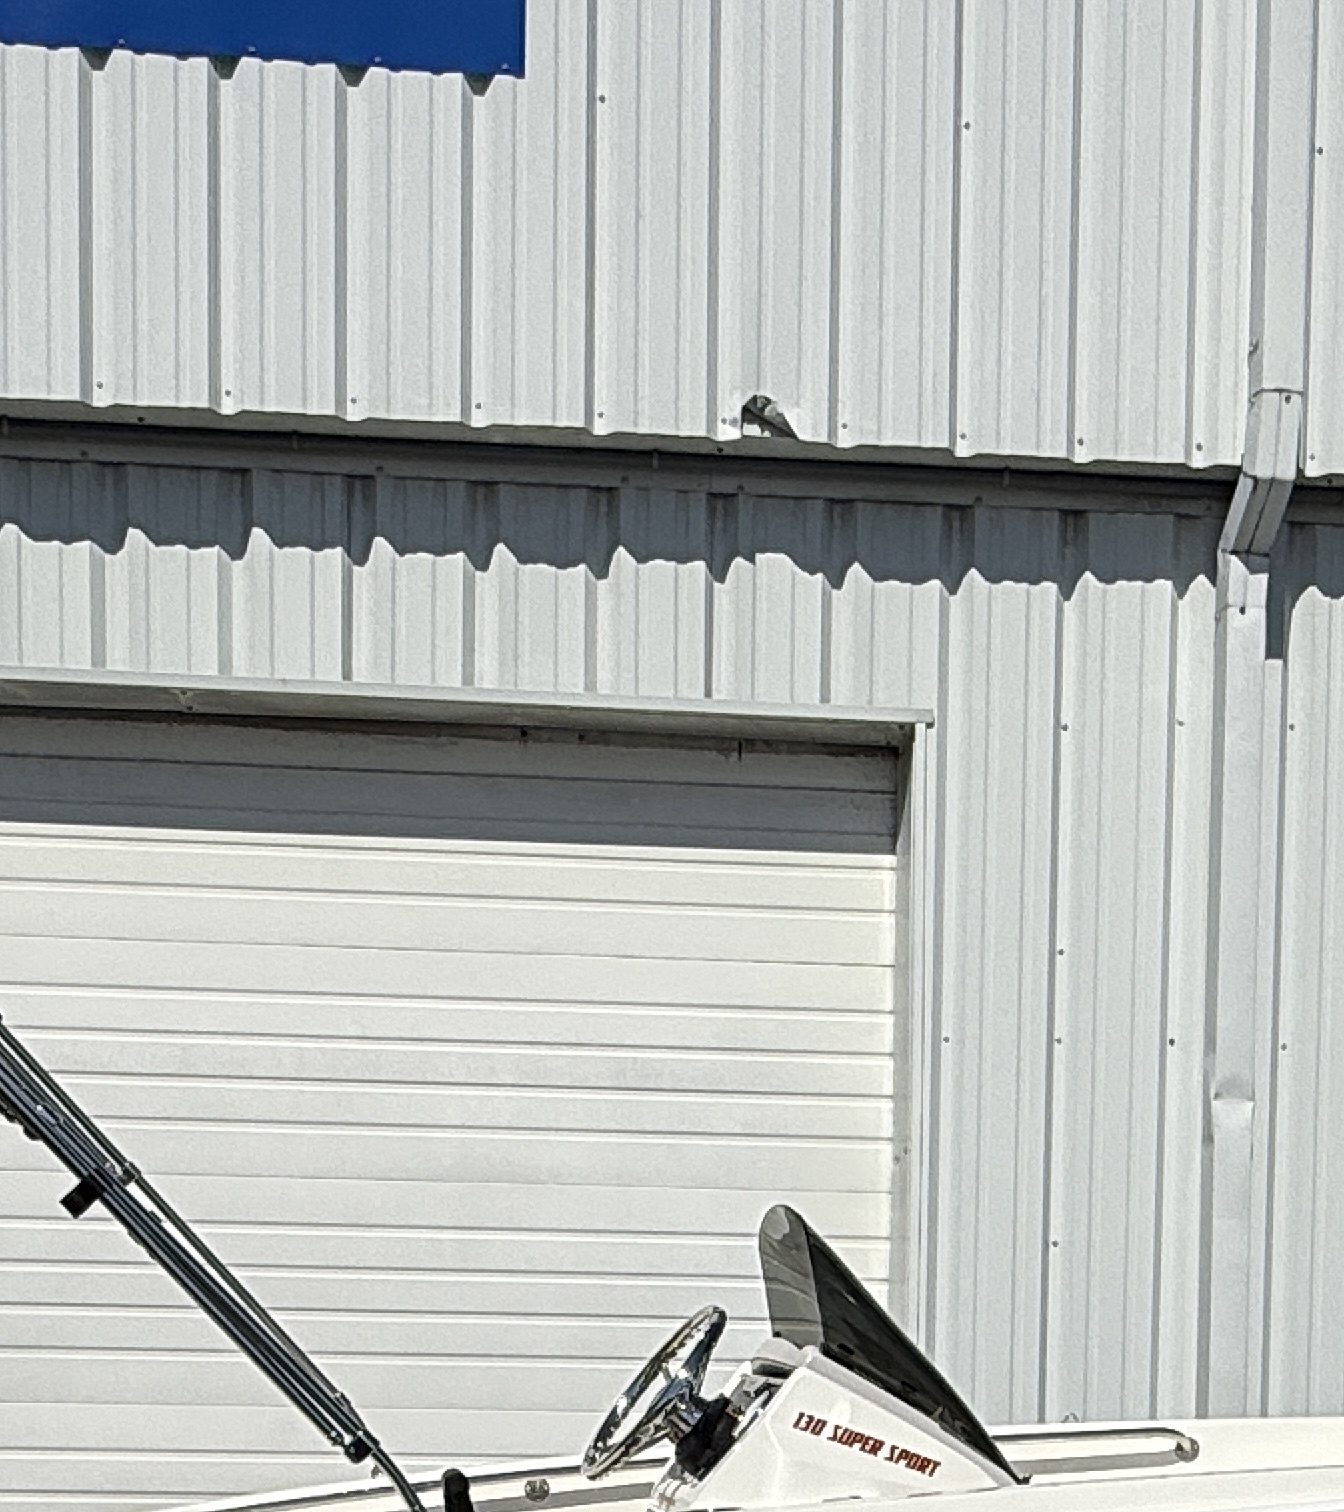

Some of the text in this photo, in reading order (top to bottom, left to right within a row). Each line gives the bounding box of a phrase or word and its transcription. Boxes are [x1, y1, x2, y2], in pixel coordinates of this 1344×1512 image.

[792, 1412, 941, 1477] 130 SUPER SPORT
